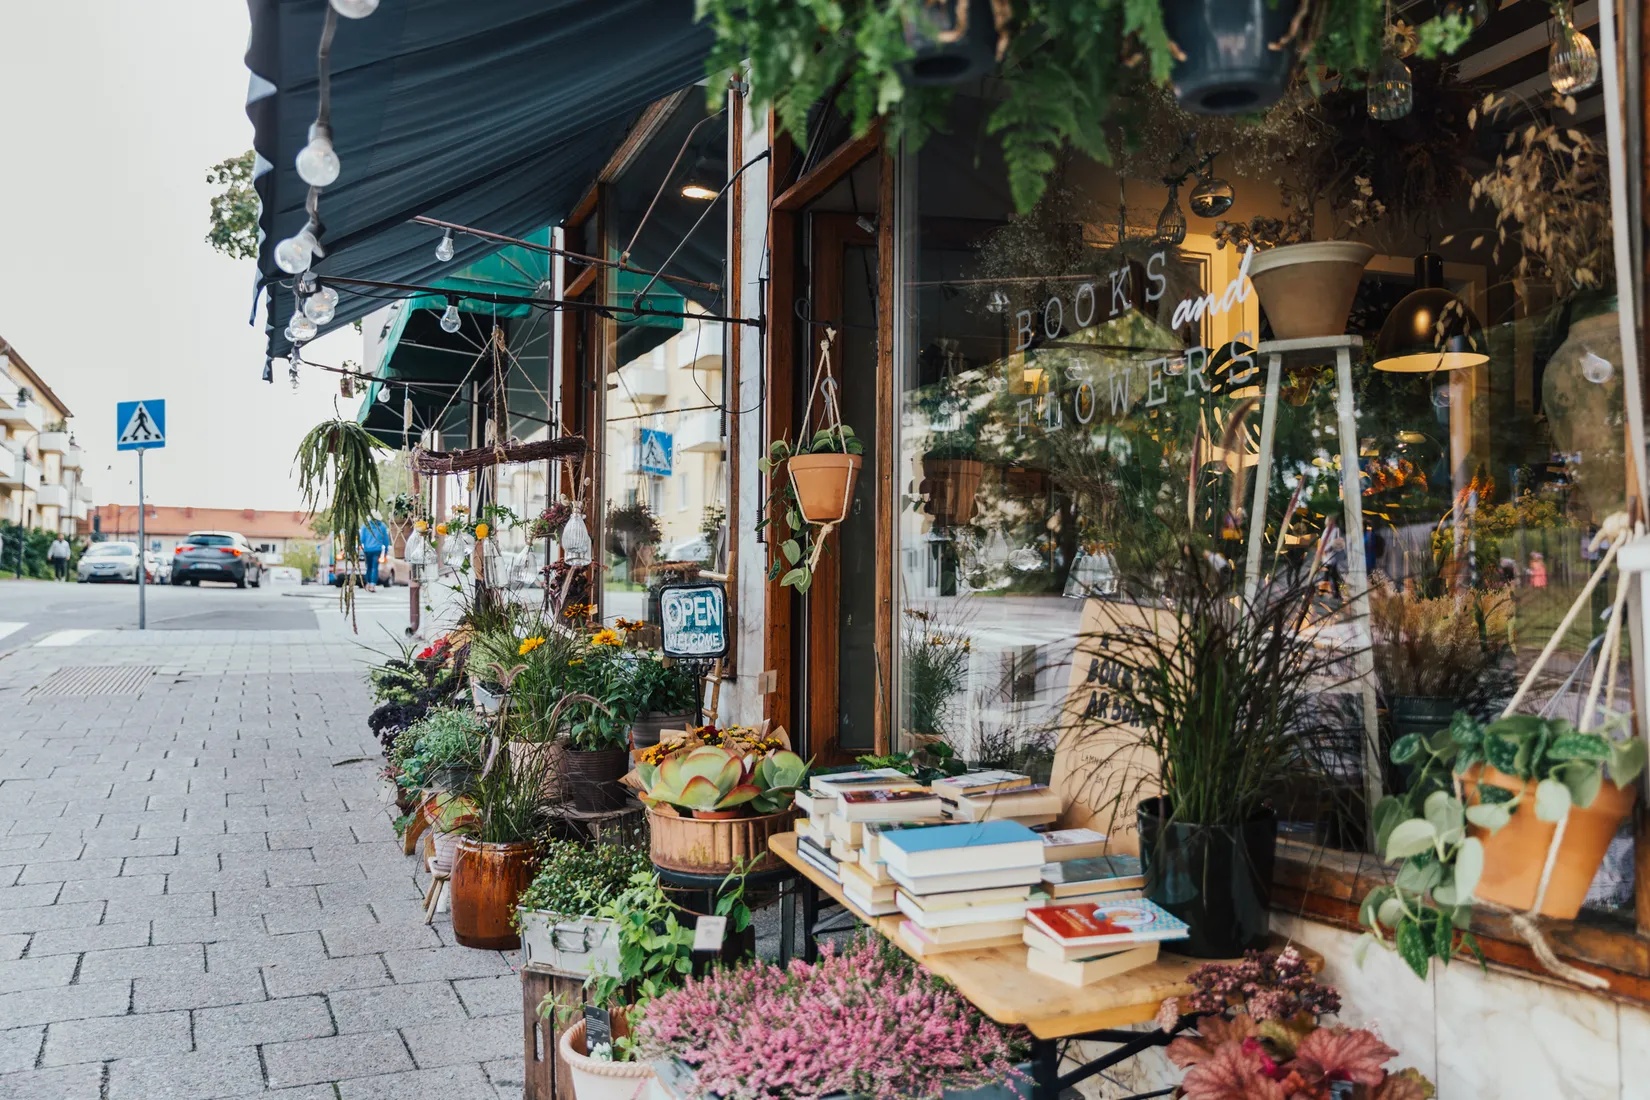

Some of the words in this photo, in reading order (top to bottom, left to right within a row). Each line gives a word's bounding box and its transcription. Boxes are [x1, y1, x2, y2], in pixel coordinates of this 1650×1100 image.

[1015, 251, 1167, 351] BOOKS
[1171, 244, 1254, 330] and
[1016, 329, 1254, 442] FLOWERS
[665, 596, 720, 627] OPEN
[667, 632, 720, 647] WELCOME
